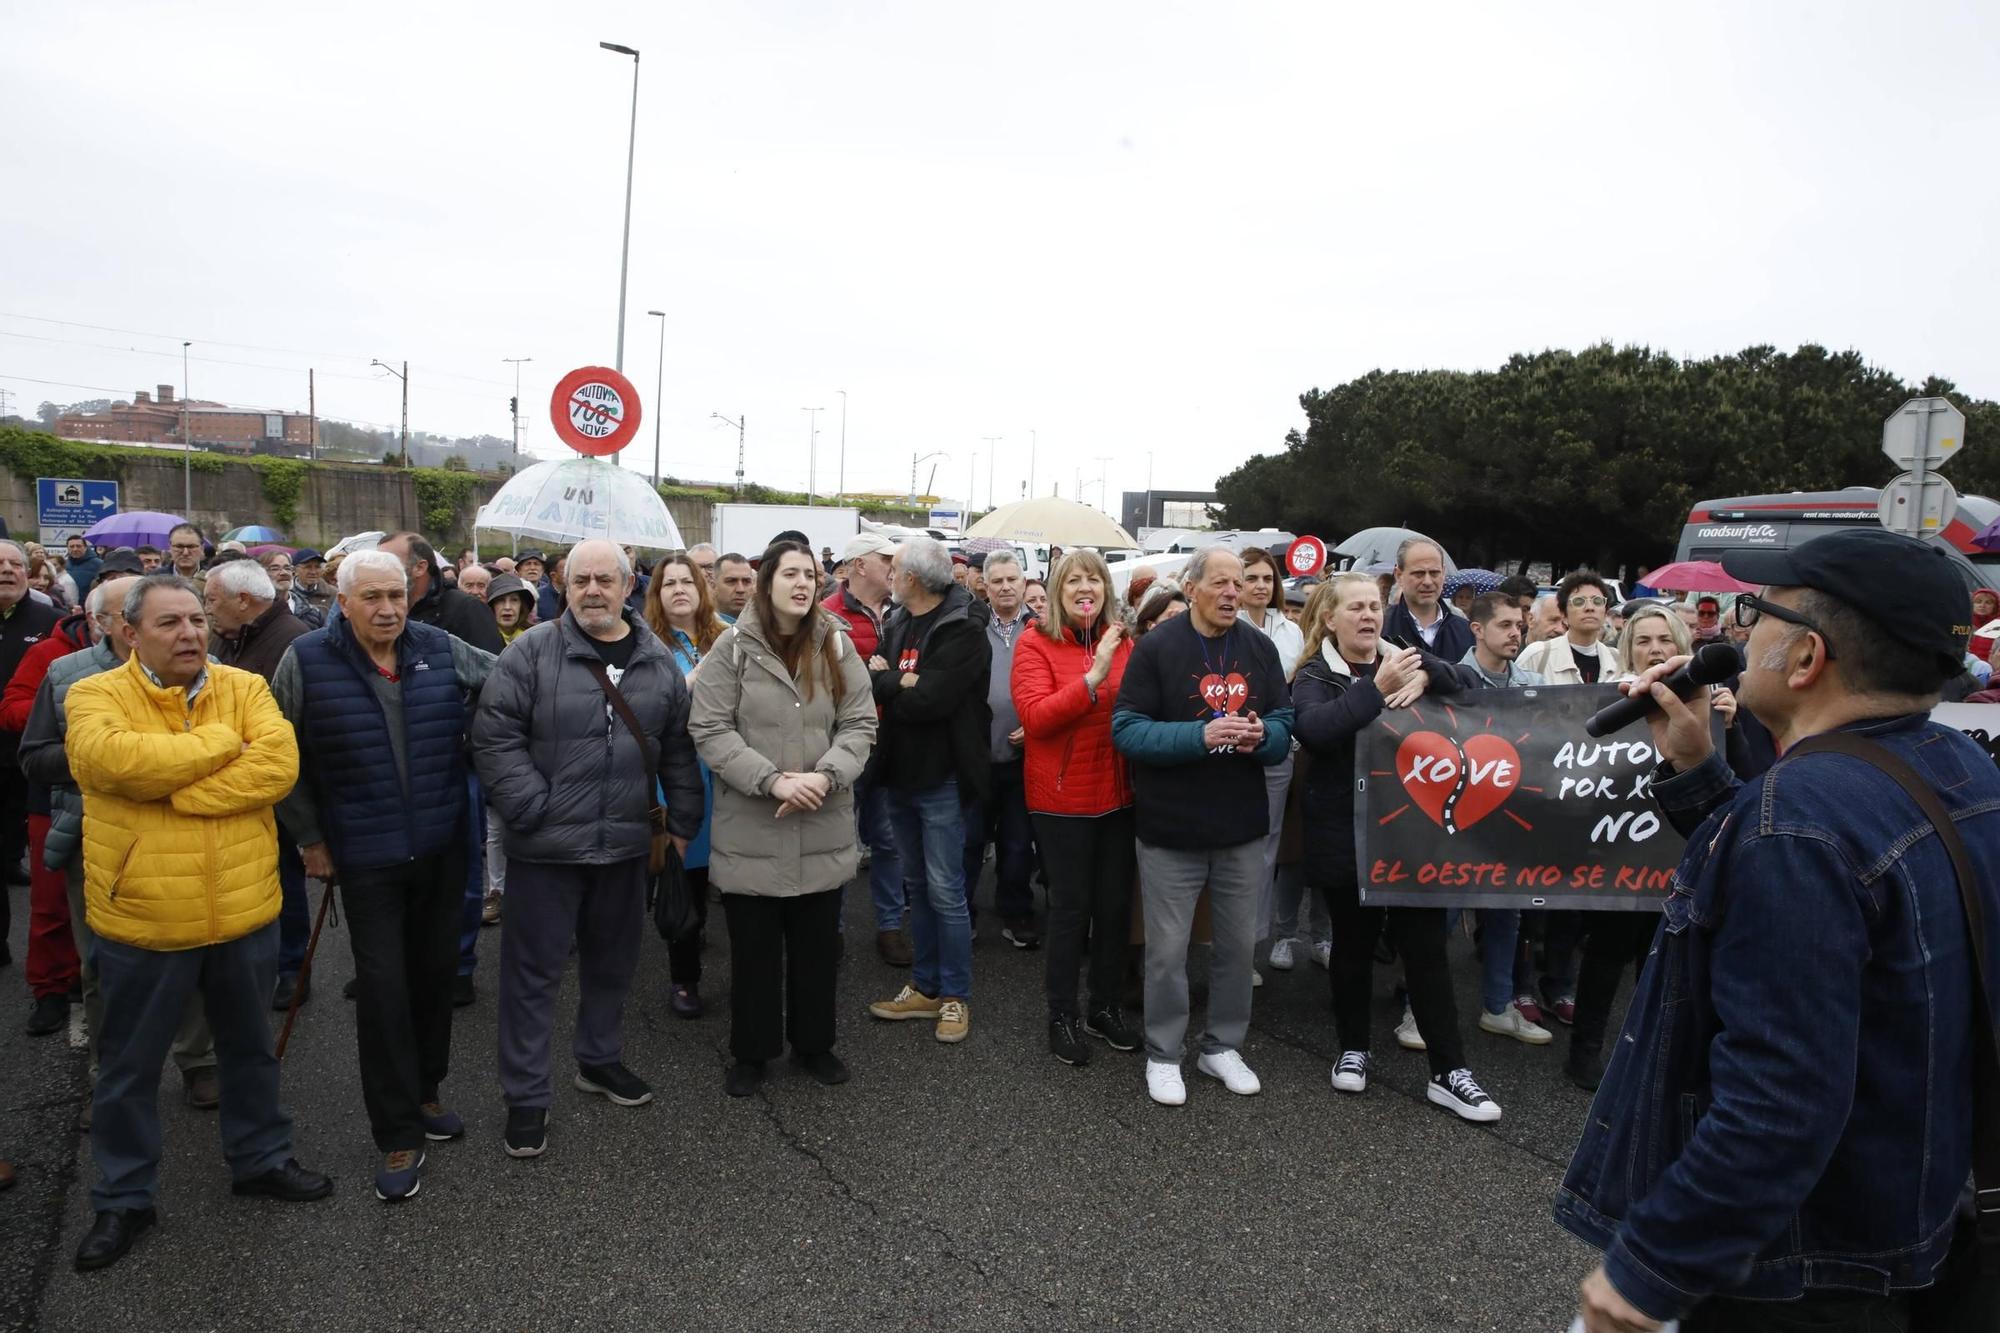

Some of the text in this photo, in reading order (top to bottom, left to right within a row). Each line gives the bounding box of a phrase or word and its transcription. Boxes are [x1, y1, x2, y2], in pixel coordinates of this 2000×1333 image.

[577, 423, 609, 436] JOVE
[563, 486, 594, 505] UN
[1698, 525, 1777, 539] roadsurfer
[1205, 684, 1245, 698] XOVE
[1402, 755, 1515, 787] XOVE
[1559, 775, 1618, 800] POR
[1590, 810, 1660, 843] NO
[1370, 859, 1409, 883] EL
[1416, 862, 1507, 886] OESTE
[1515, 865, 1562, 887] NO
[1570, 865, 1606, 888] SE
